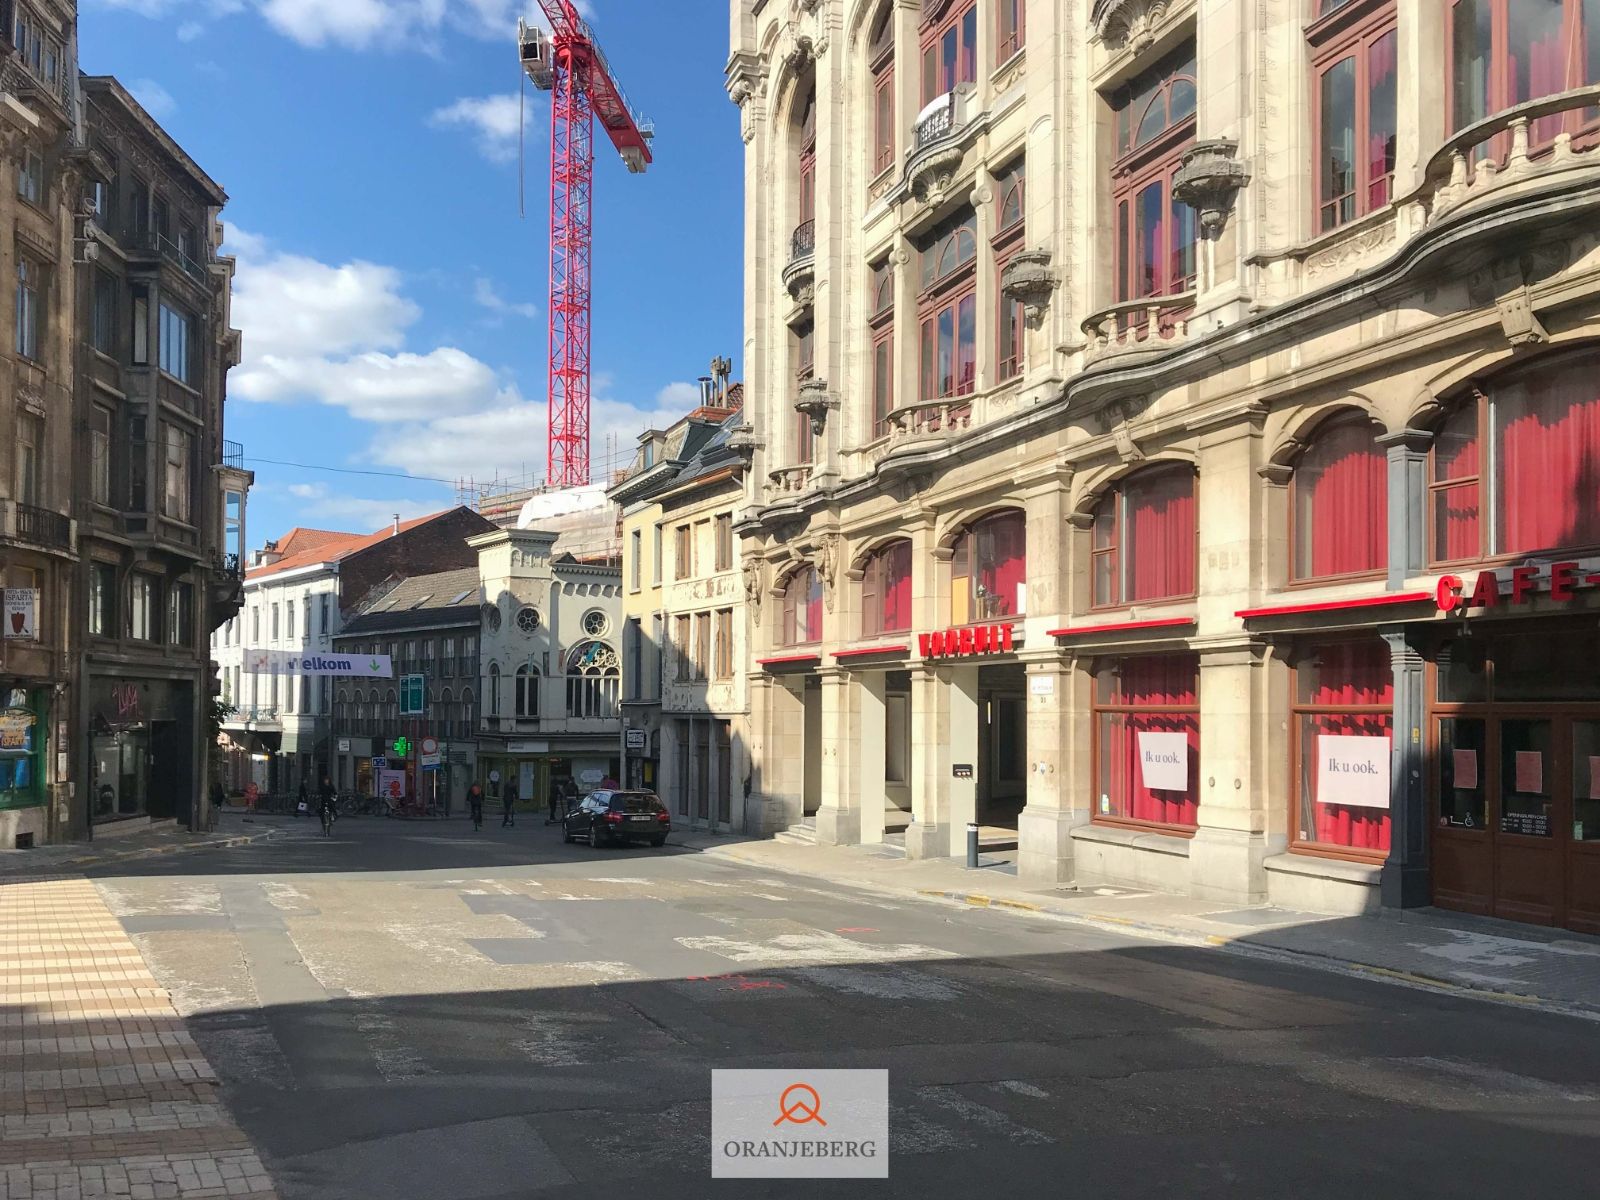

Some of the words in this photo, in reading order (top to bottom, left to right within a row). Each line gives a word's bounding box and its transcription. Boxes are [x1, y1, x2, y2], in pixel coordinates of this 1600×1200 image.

[1437, 562, 1579, 611] CAFE
[918, 623, 1014, 657] VOORUIT
[288, 657, 351, 670] Welkom
[1145, 750, 1153, 762] Ik
[1155, 754, 1161, 763] u
[1162, 751, 1180, 764] ook.
[1329, 758, 1340, 771] Ik
[1342, 763, 1350, 772] u
[1352, 760, 1378, 774] ook.
